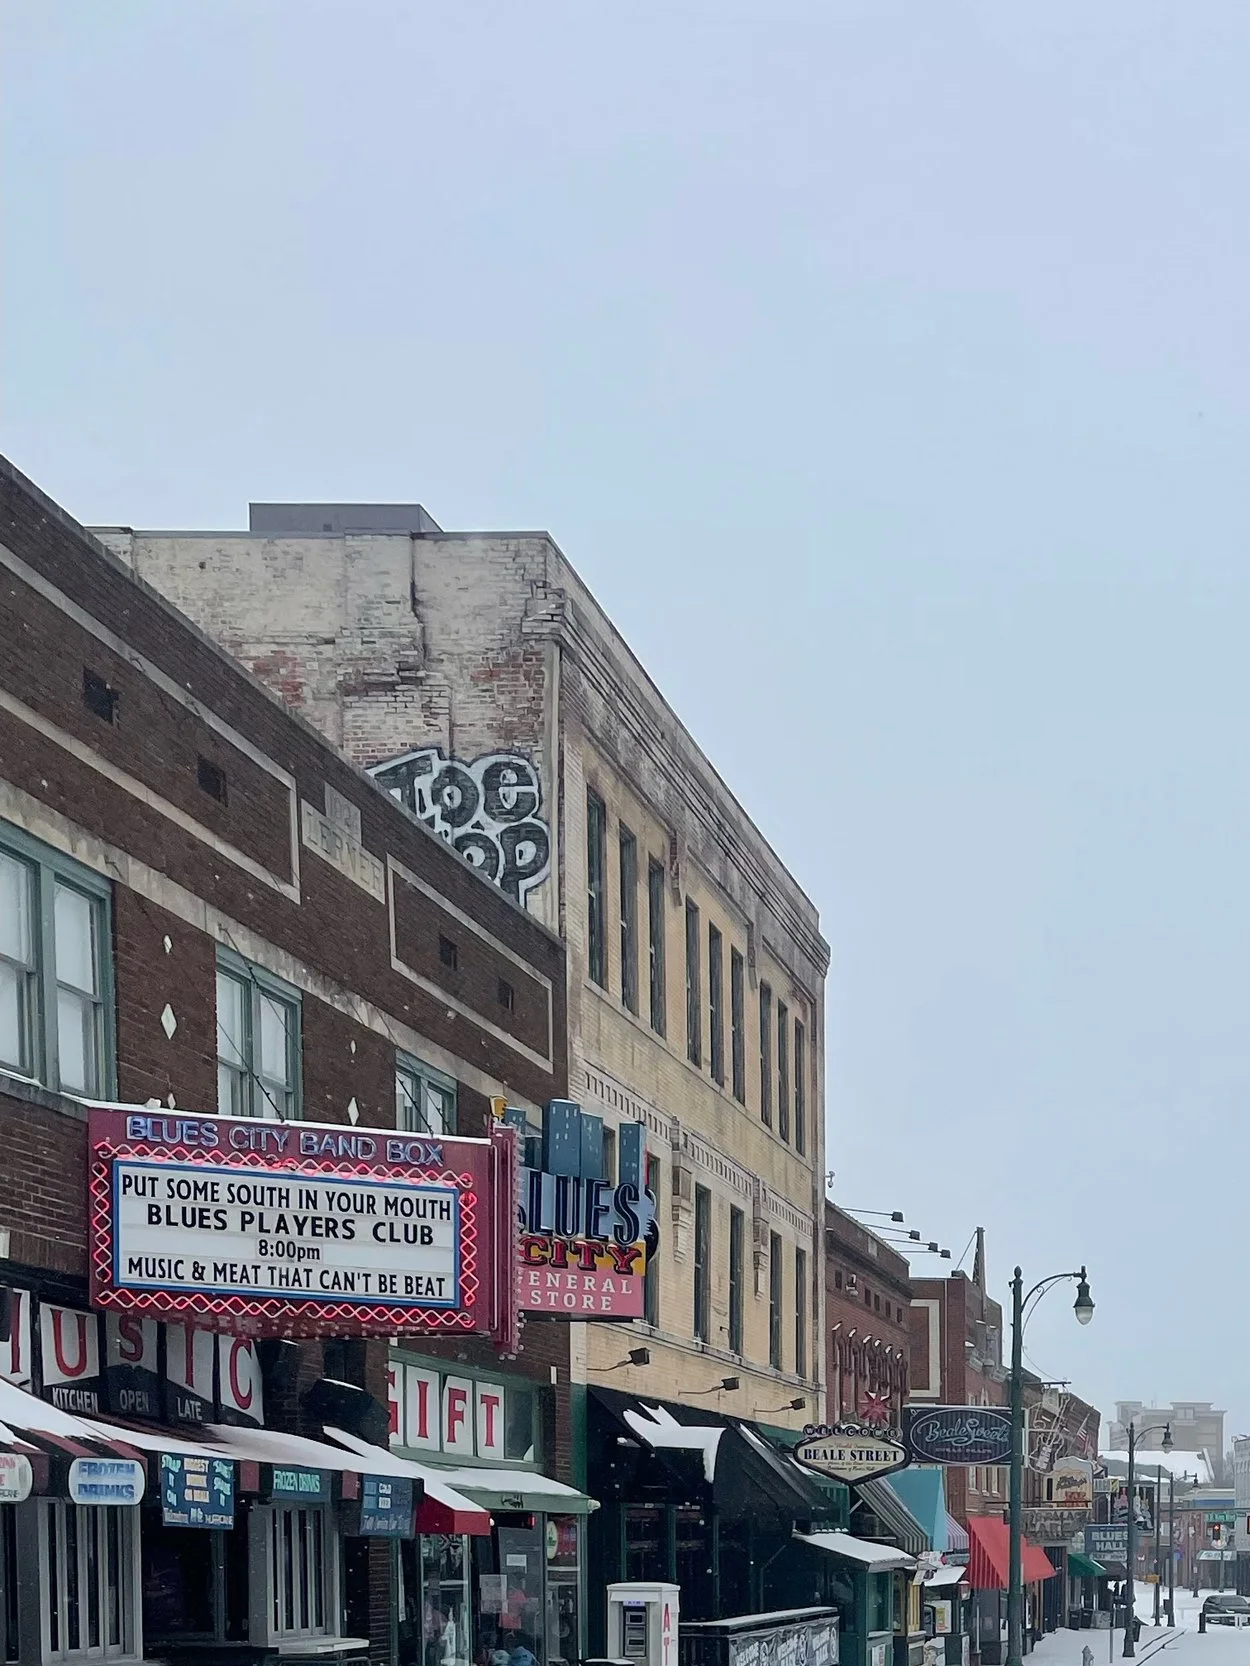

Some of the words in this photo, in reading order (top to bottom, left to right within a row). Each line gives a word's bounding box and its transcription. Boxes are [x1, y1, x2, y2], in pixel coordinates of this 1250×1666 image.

[127, 1116, 218, 1147] BLUES
[229, 1125, 290, 1153] CITY
[300, 1132, 377, 1162] BAND
[387, 1140, 444, 1167] BOX
[122, 1174, 159, 1198] PUT
[167, 1178, 219, 1203] SOME
[227, 1183, 290, 1209] SOUTH
[299, 1188, 317, 1211] IN
[326, 1190, 376, 1216] YOUR
[384, 1196, 451, 1221] MOUTH
[519, 1170, 640, 1247] LUES
[147, 1204, 227, 1231] BLUES
[241, 1210, 355, 1240] PLAYERS
[372, 1222, 434, 1246] CLUB
[259, 1240, 321, 1262] 8:00pm
[519, 1235, 643, 1275] CITY
[128, 1257, 185, 1281] MUSIC
[192, 1262, 206, 1282] &
[213, 1263, 261, 1287] MEAT
[267, 1266, 312, 1290] THAT
[319, 1270, 372, 1293] CAN'T
[378, 1274, 398, 1294] BE
[405, 1276, 446, 1297] BEAT
[519, 1271, 633, 1294] ENERAL
[531, 1290, 613, 1311] STORE
[10, 1293, 253, 1410] USIC
[52, 1386, 99, 1415] KITCHEN
[119, 1390, 150, 1412] OPEN
[177, 1396, 203, 1421] LATE
[804, 1425, 897, 1438] WELCOME
[917, 1418, 965, 1442] Beale
[804, 1449, 846, 1460] BEALE
[850, 1449, 899, 1461] STREET
[78, 1461, 135, 1477] FROZEN
[273, 1470, 298, 1491] FROZEN
[77, 1483, 135, 1498] DRINKS
[1091, 1532, 1128, 1540] BLUES
[1096, 1542, 1126, 1551] HALL
